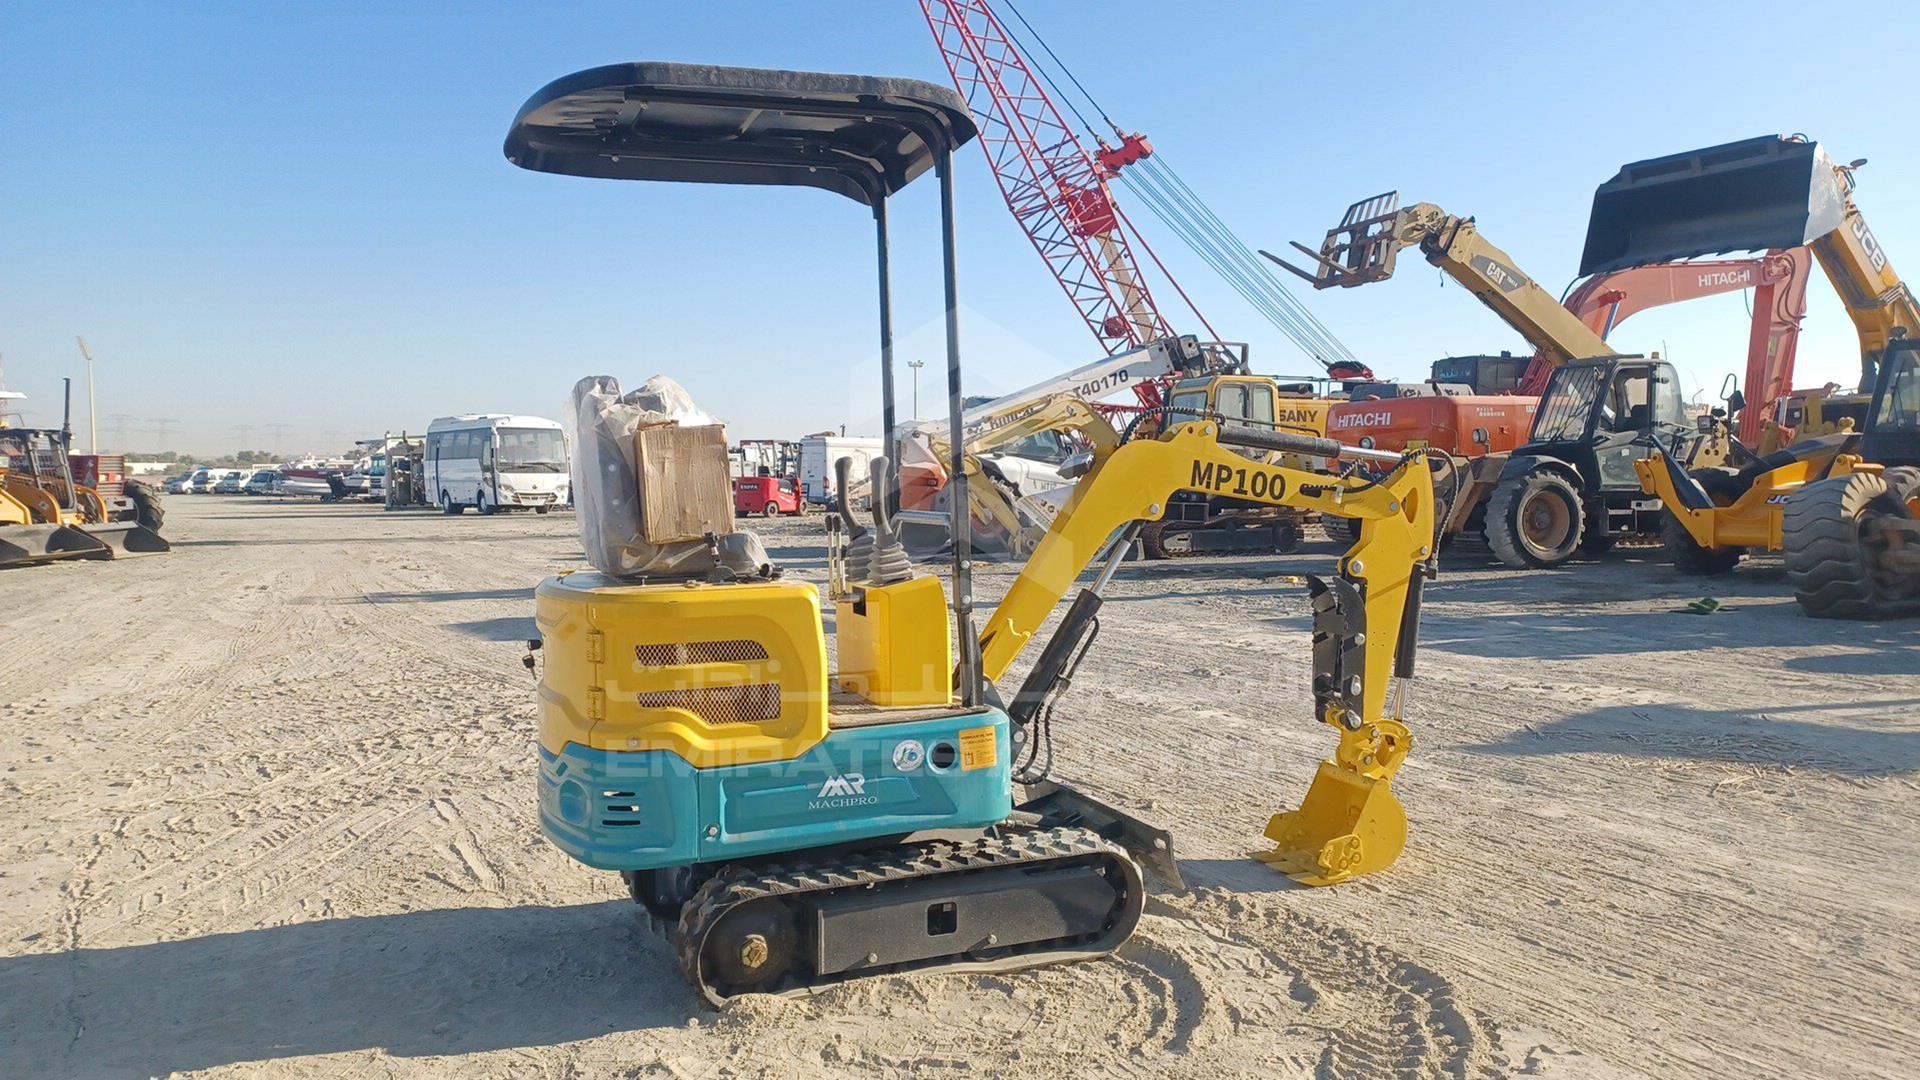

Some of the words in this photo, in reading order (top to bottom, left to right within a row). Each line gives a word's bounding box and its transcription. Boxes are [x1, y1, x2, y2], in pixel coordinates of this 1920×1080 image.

[1852, 221, 1887, 273] JCB
[1486, 261, 1507, 285] CAT
[1698, 269, 1751, 288] HITACHI
[1279, 409, 1318, 423] SANY
[1337, 411, 1392, 428] HITACHI
[1190, 459, 1286, 500] MP100
[1766, 494, 1792, 504] JC
[808, 796, 878, 810] MACHPRO
